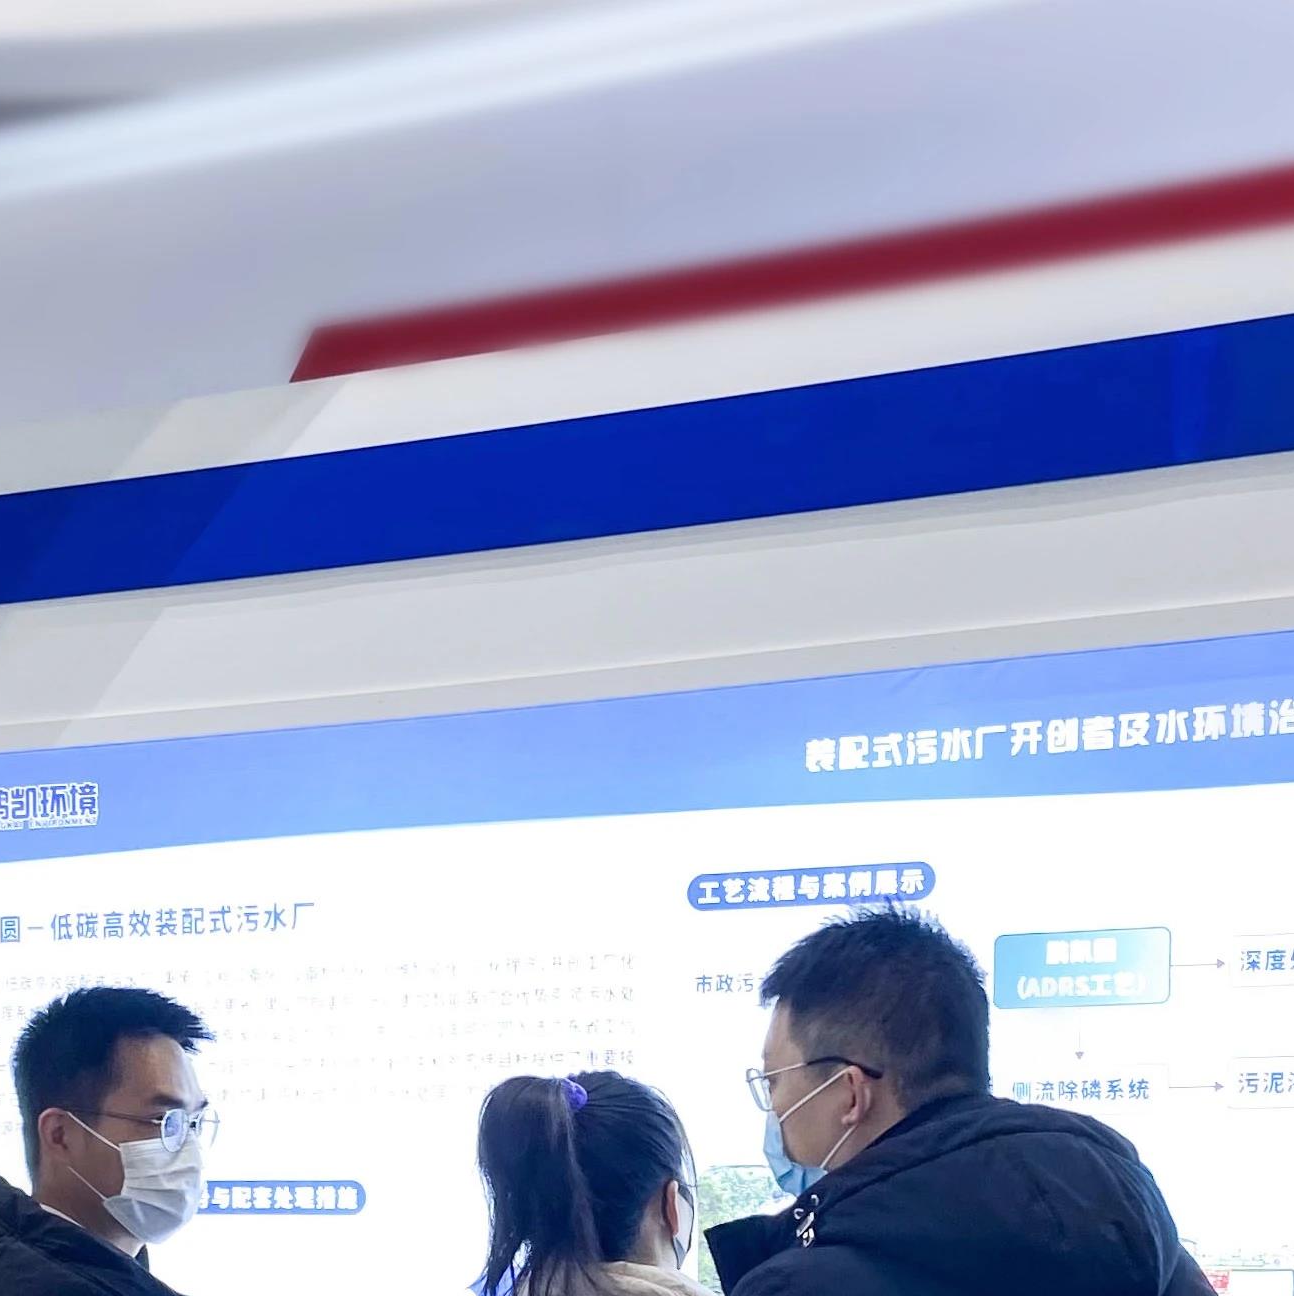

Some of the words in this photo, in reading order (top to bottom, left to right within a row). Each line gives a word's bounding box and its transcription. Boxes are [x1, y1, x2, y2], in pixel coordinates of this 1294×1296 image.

[698, 868, 925, 904] 工艺流程与案例展示
[696, 973, 766, 994] 市政污
[1012, 1078, 1150, 1101] 侧流除磷系统
